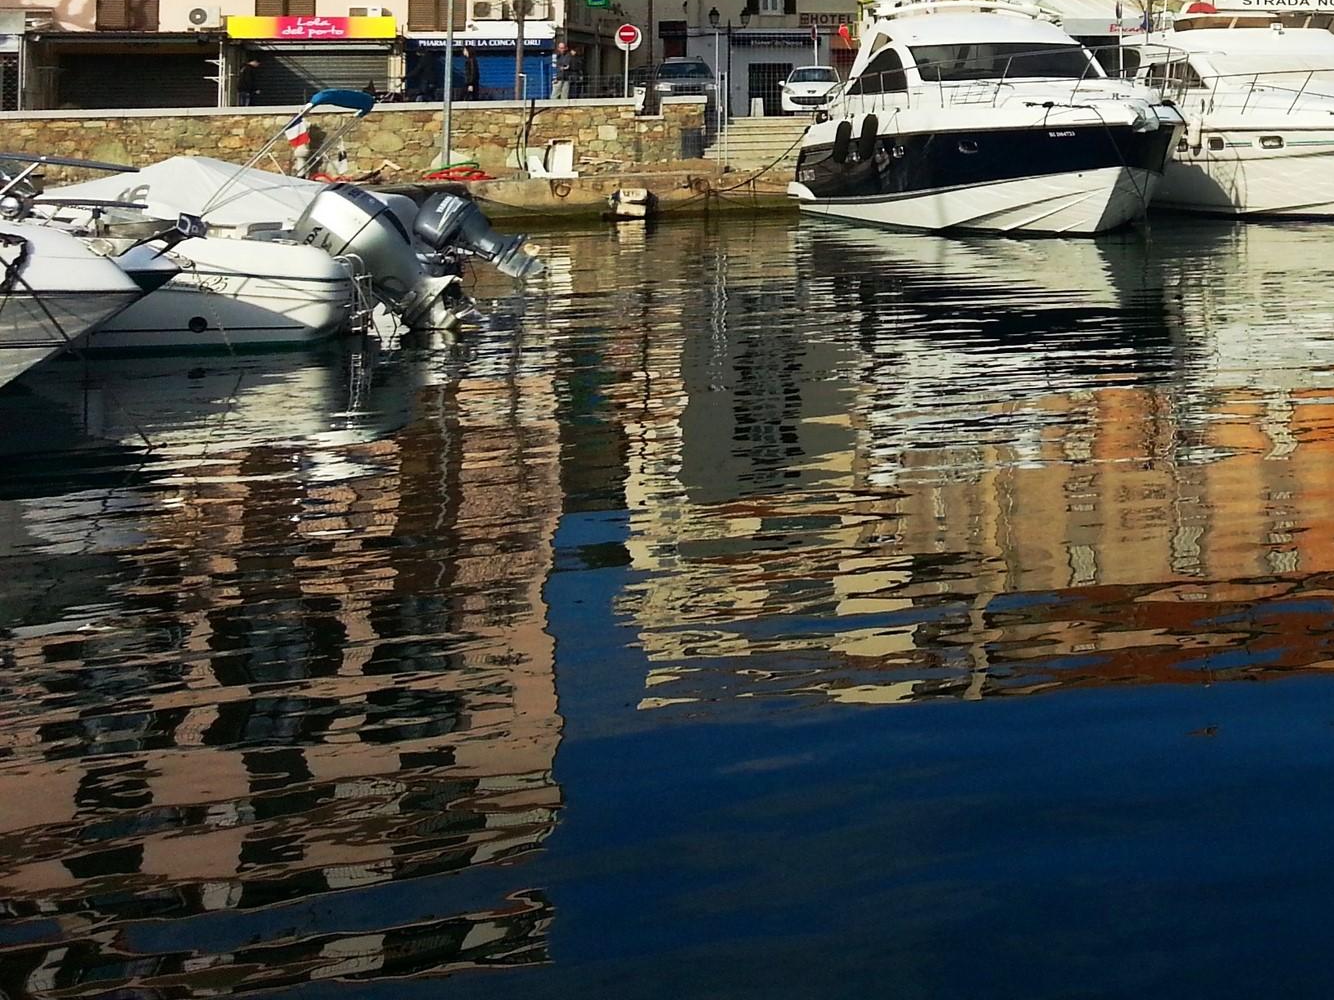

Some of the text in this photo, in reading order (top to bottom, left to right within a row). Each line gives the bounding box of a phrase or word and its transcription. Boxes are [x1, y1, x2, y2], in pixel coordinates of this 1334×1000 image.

[297, 17, 331, 27] Lola
[810, 14, 853, 24] HOTEL
[281, 27, 345, 38] del porto
